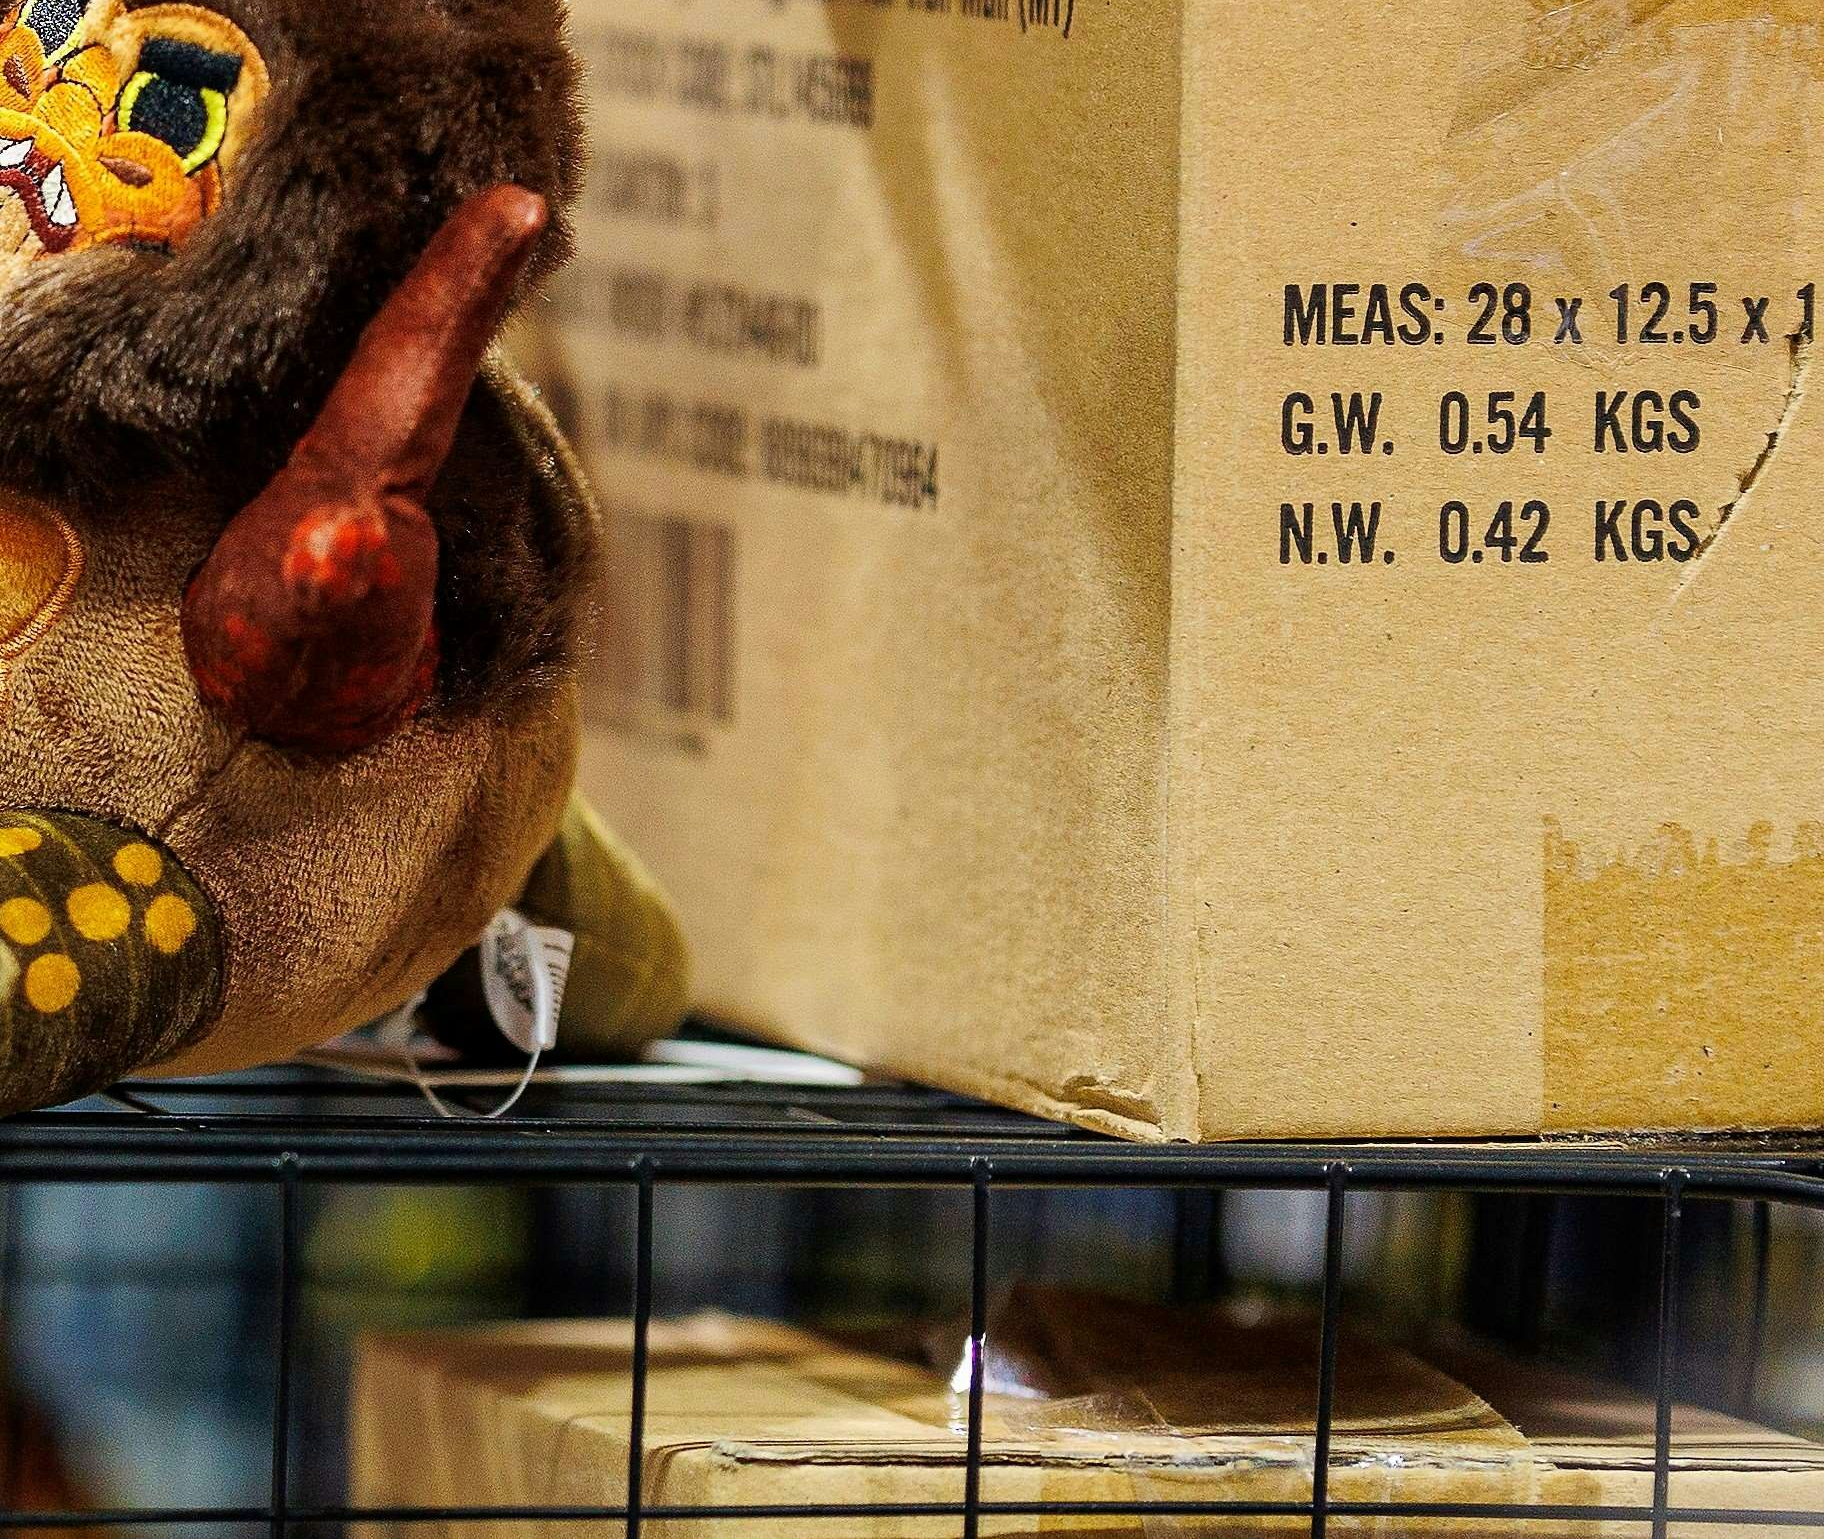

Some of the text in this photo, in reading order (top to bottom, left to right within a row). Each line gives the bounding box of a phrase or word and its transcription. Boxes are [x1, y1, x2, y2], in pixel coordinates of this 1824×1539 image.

[1283, 283, 1444, 346] MEAS:
[1467, 282, 1531, 345] 28
[1554, 297, 1583, 344] x
[1608, 282, 1718, 344] 12.5
[1740, 296, 1770, 344] x
[1281, 390, 1700, 455] G.W. 0.54 KGS
[1280, 499, 1699, 564] N.W. 0.42 KGS
